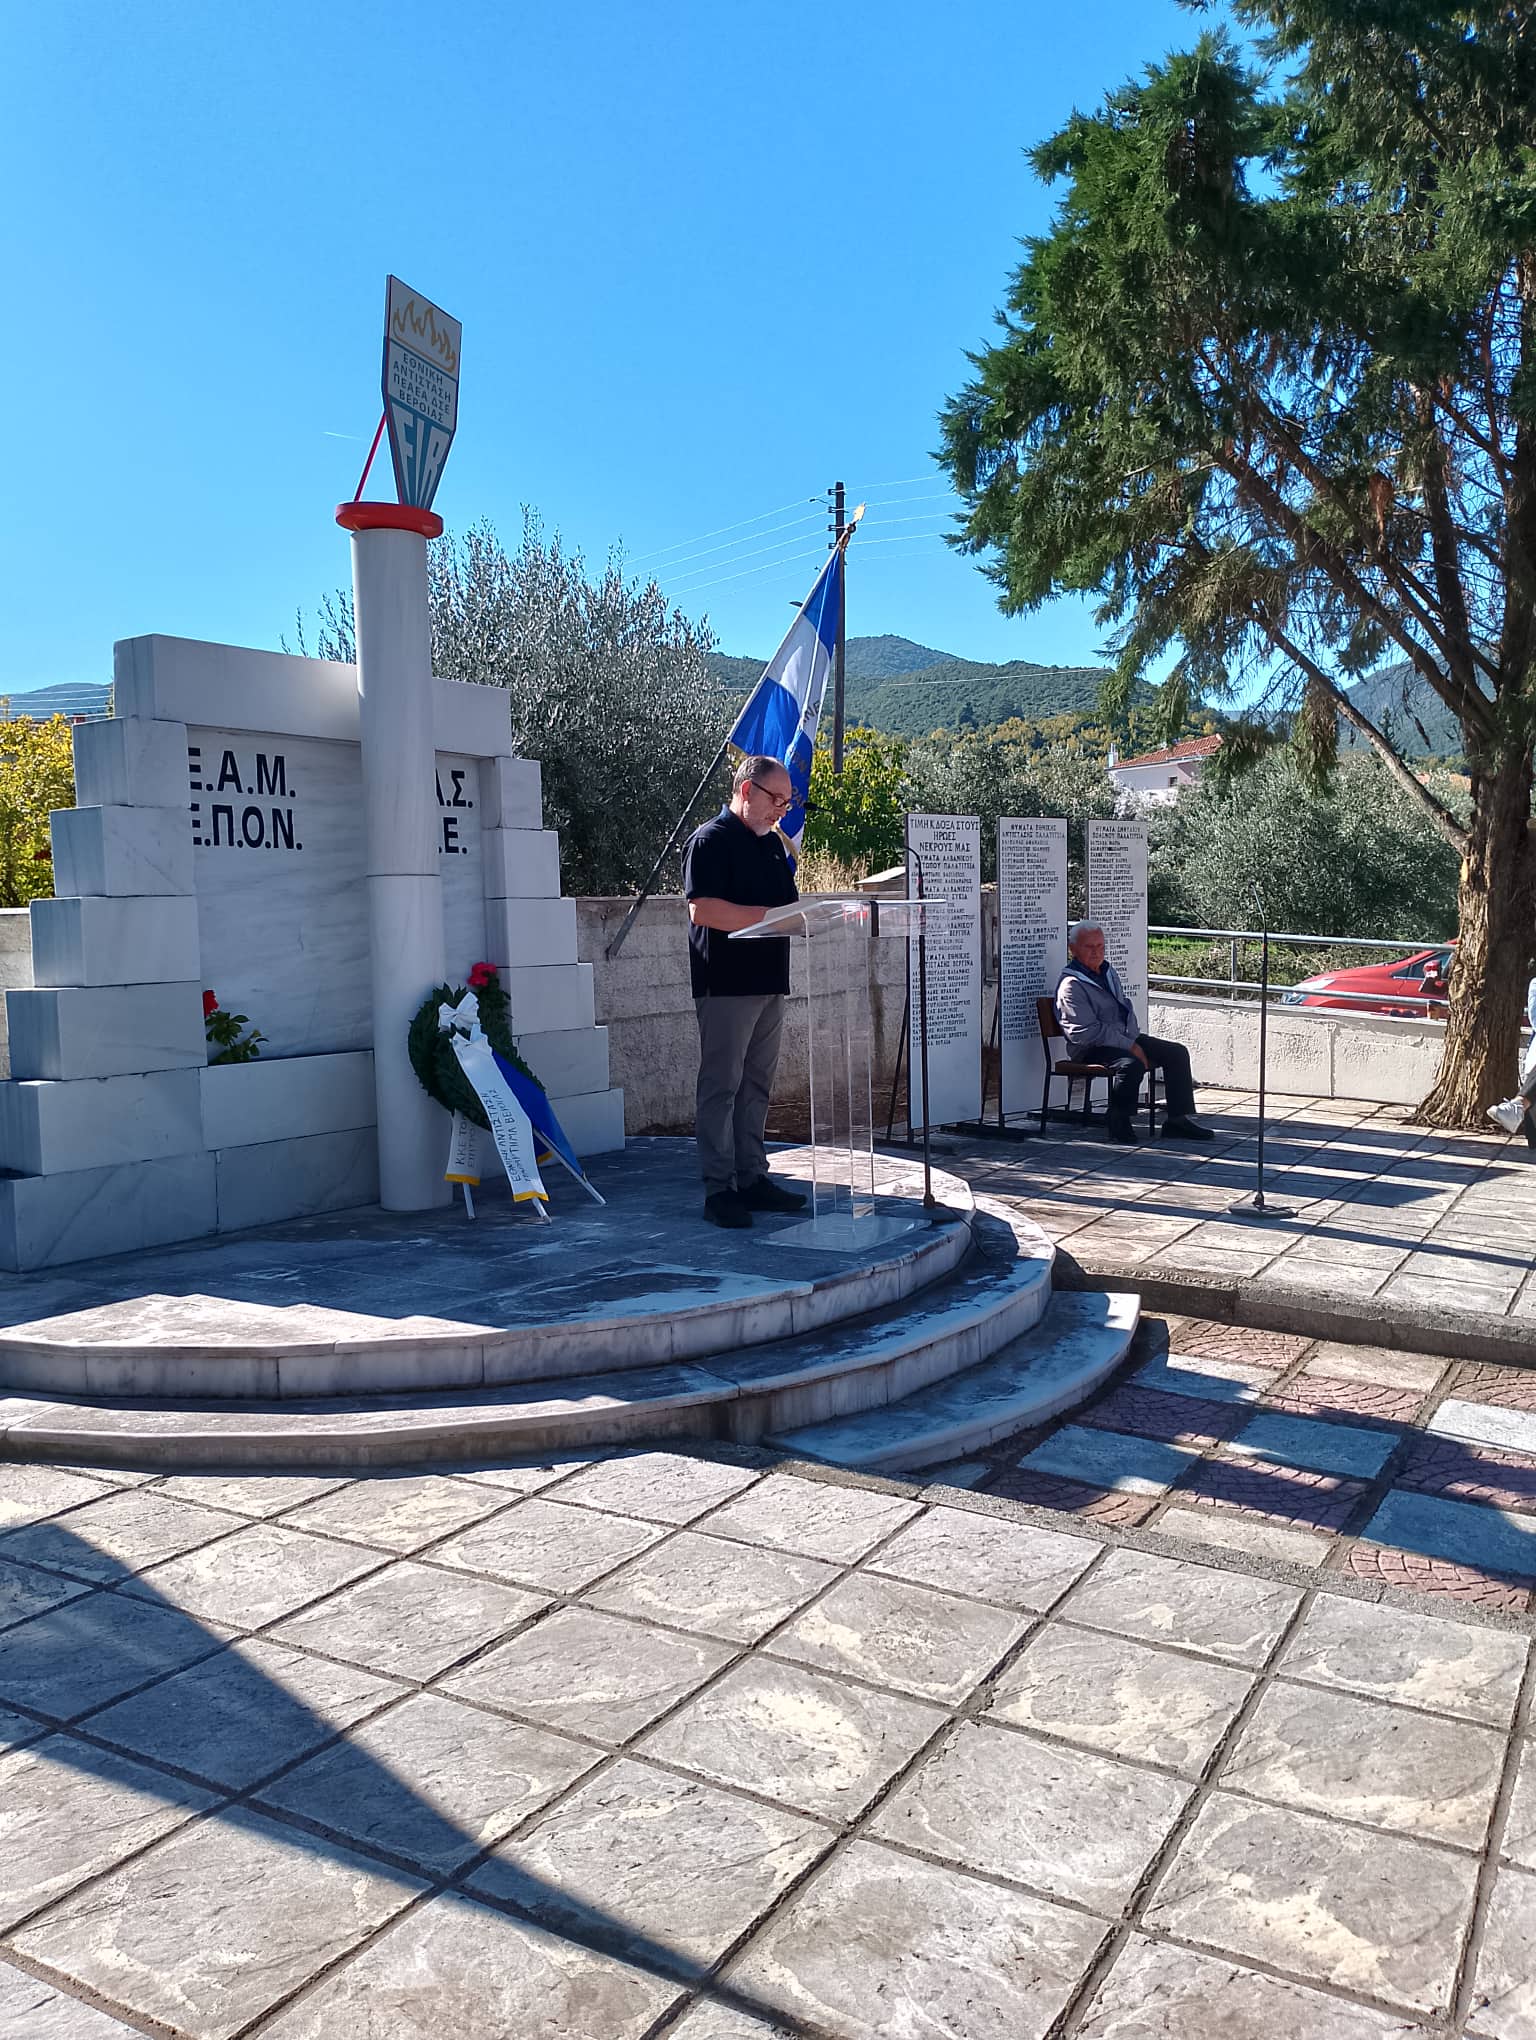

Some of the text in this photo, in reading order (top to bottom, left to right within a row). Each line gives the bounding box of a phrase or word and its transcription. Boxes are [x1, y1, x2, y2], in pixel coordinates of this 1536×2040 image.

[393, 361, 451, 403] ΑΝΤΙΣΤΑΣΗ
[393, 373, 451, 414] ΠΕΑΕΑ ΔΣΕ
[399, 389, 444, 423] ΒΕΡΟΙΑΣ
[392, 403, 450, 509] FIR
[935, 820, 955, 830] ΔΟΞΑ
[956, 820, 980, 831] ΣΤΟΥΣ
[919, 842, 971, 852] ΝΕΚΡΟΥΣ ΜΑΣ
